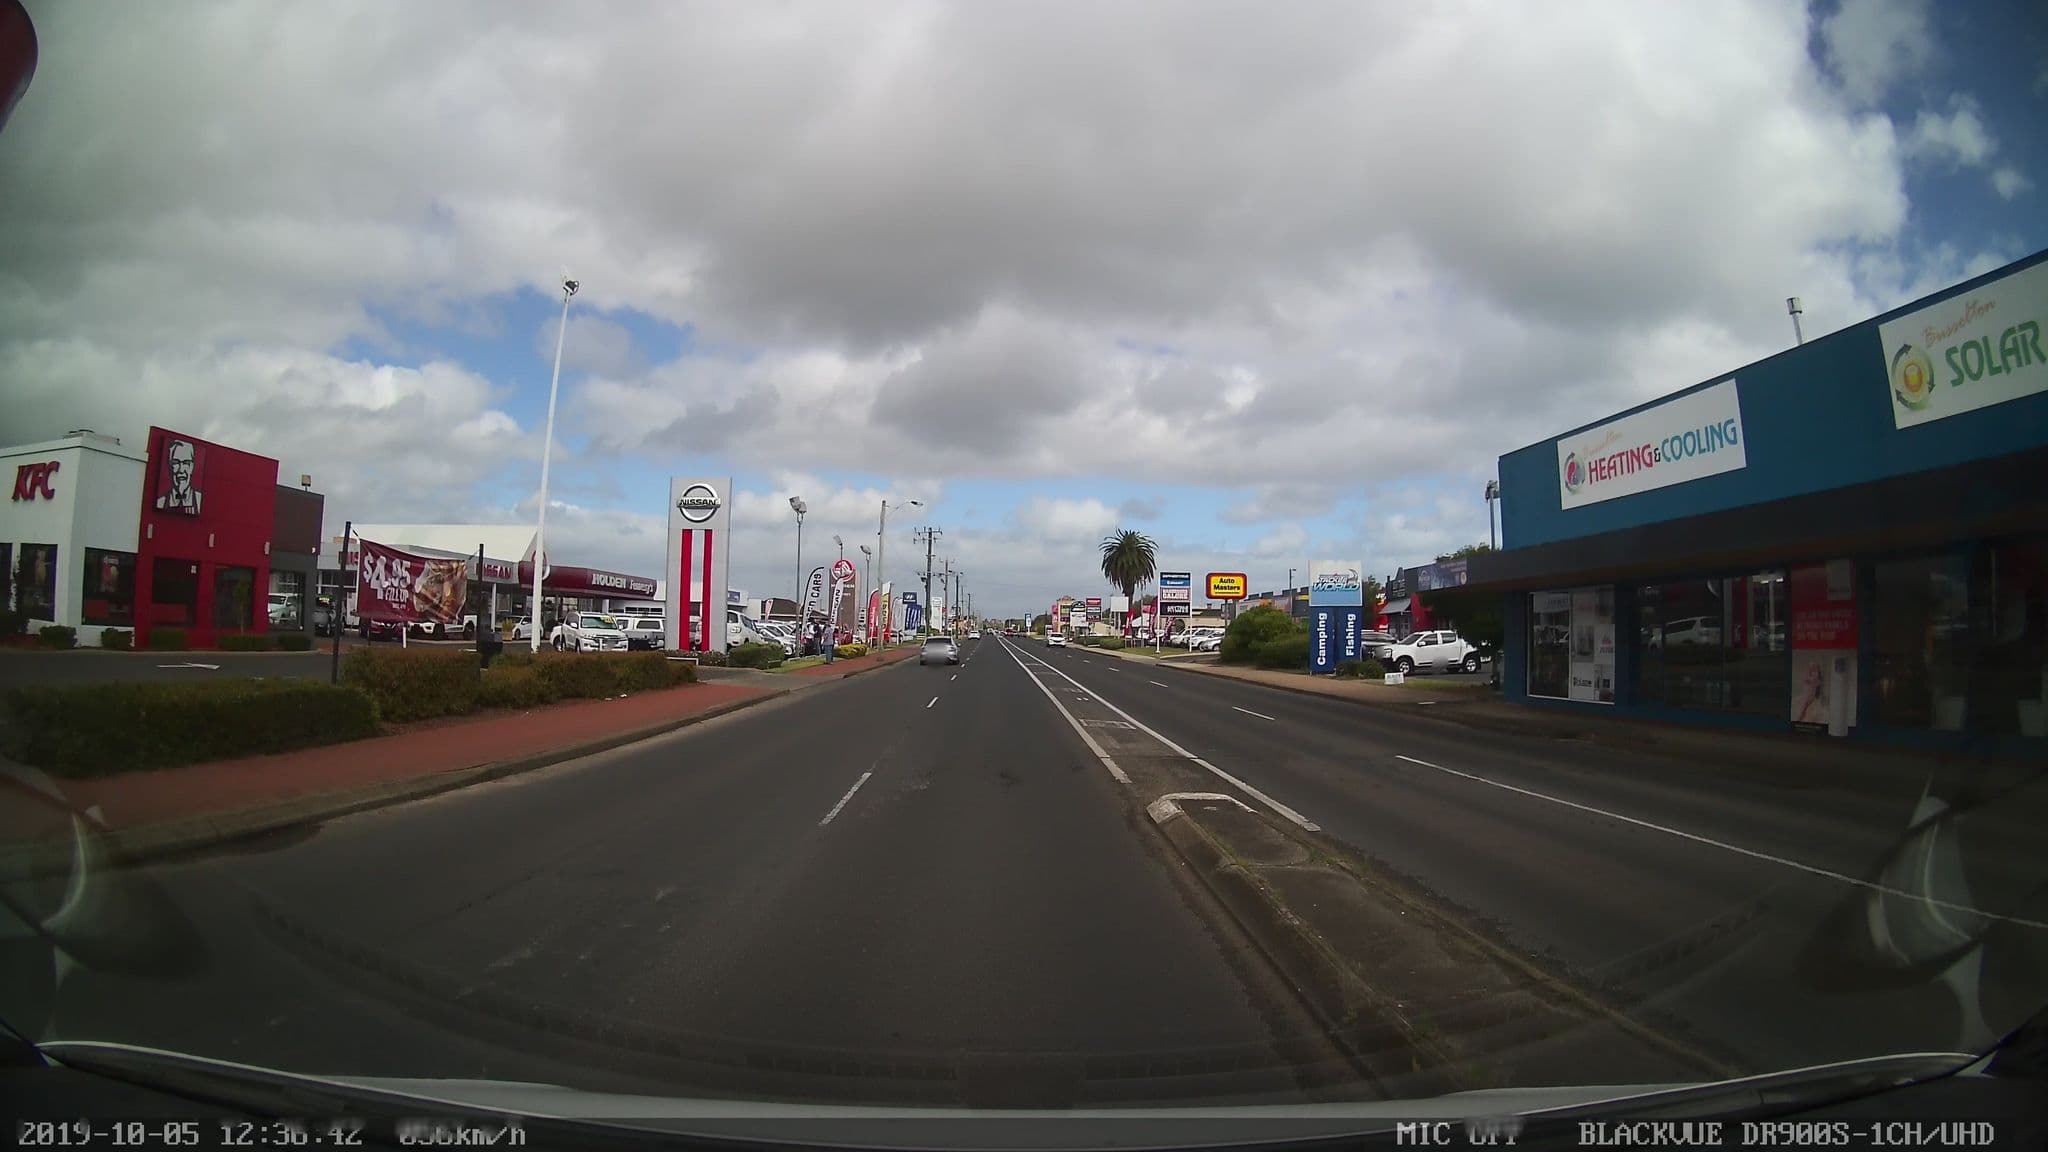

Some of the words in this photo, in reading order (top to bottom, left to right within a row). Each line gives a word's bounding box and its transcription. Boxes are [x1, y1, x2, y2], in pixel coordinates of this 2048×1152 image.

[1945, 320, 2047, 388] SOLAR
[11, 460, 60, 502] KFC
[679, 498, 716, 506] NISSAN
[363, 551, 411, 600] $4.95
[592, 573, 626, 589] HOLDEN
[1312, 582, 1360, 592] WORLD
[1316, 612, 1328, 666] Camping
[1345, 613, 1357, 657] Fishing
